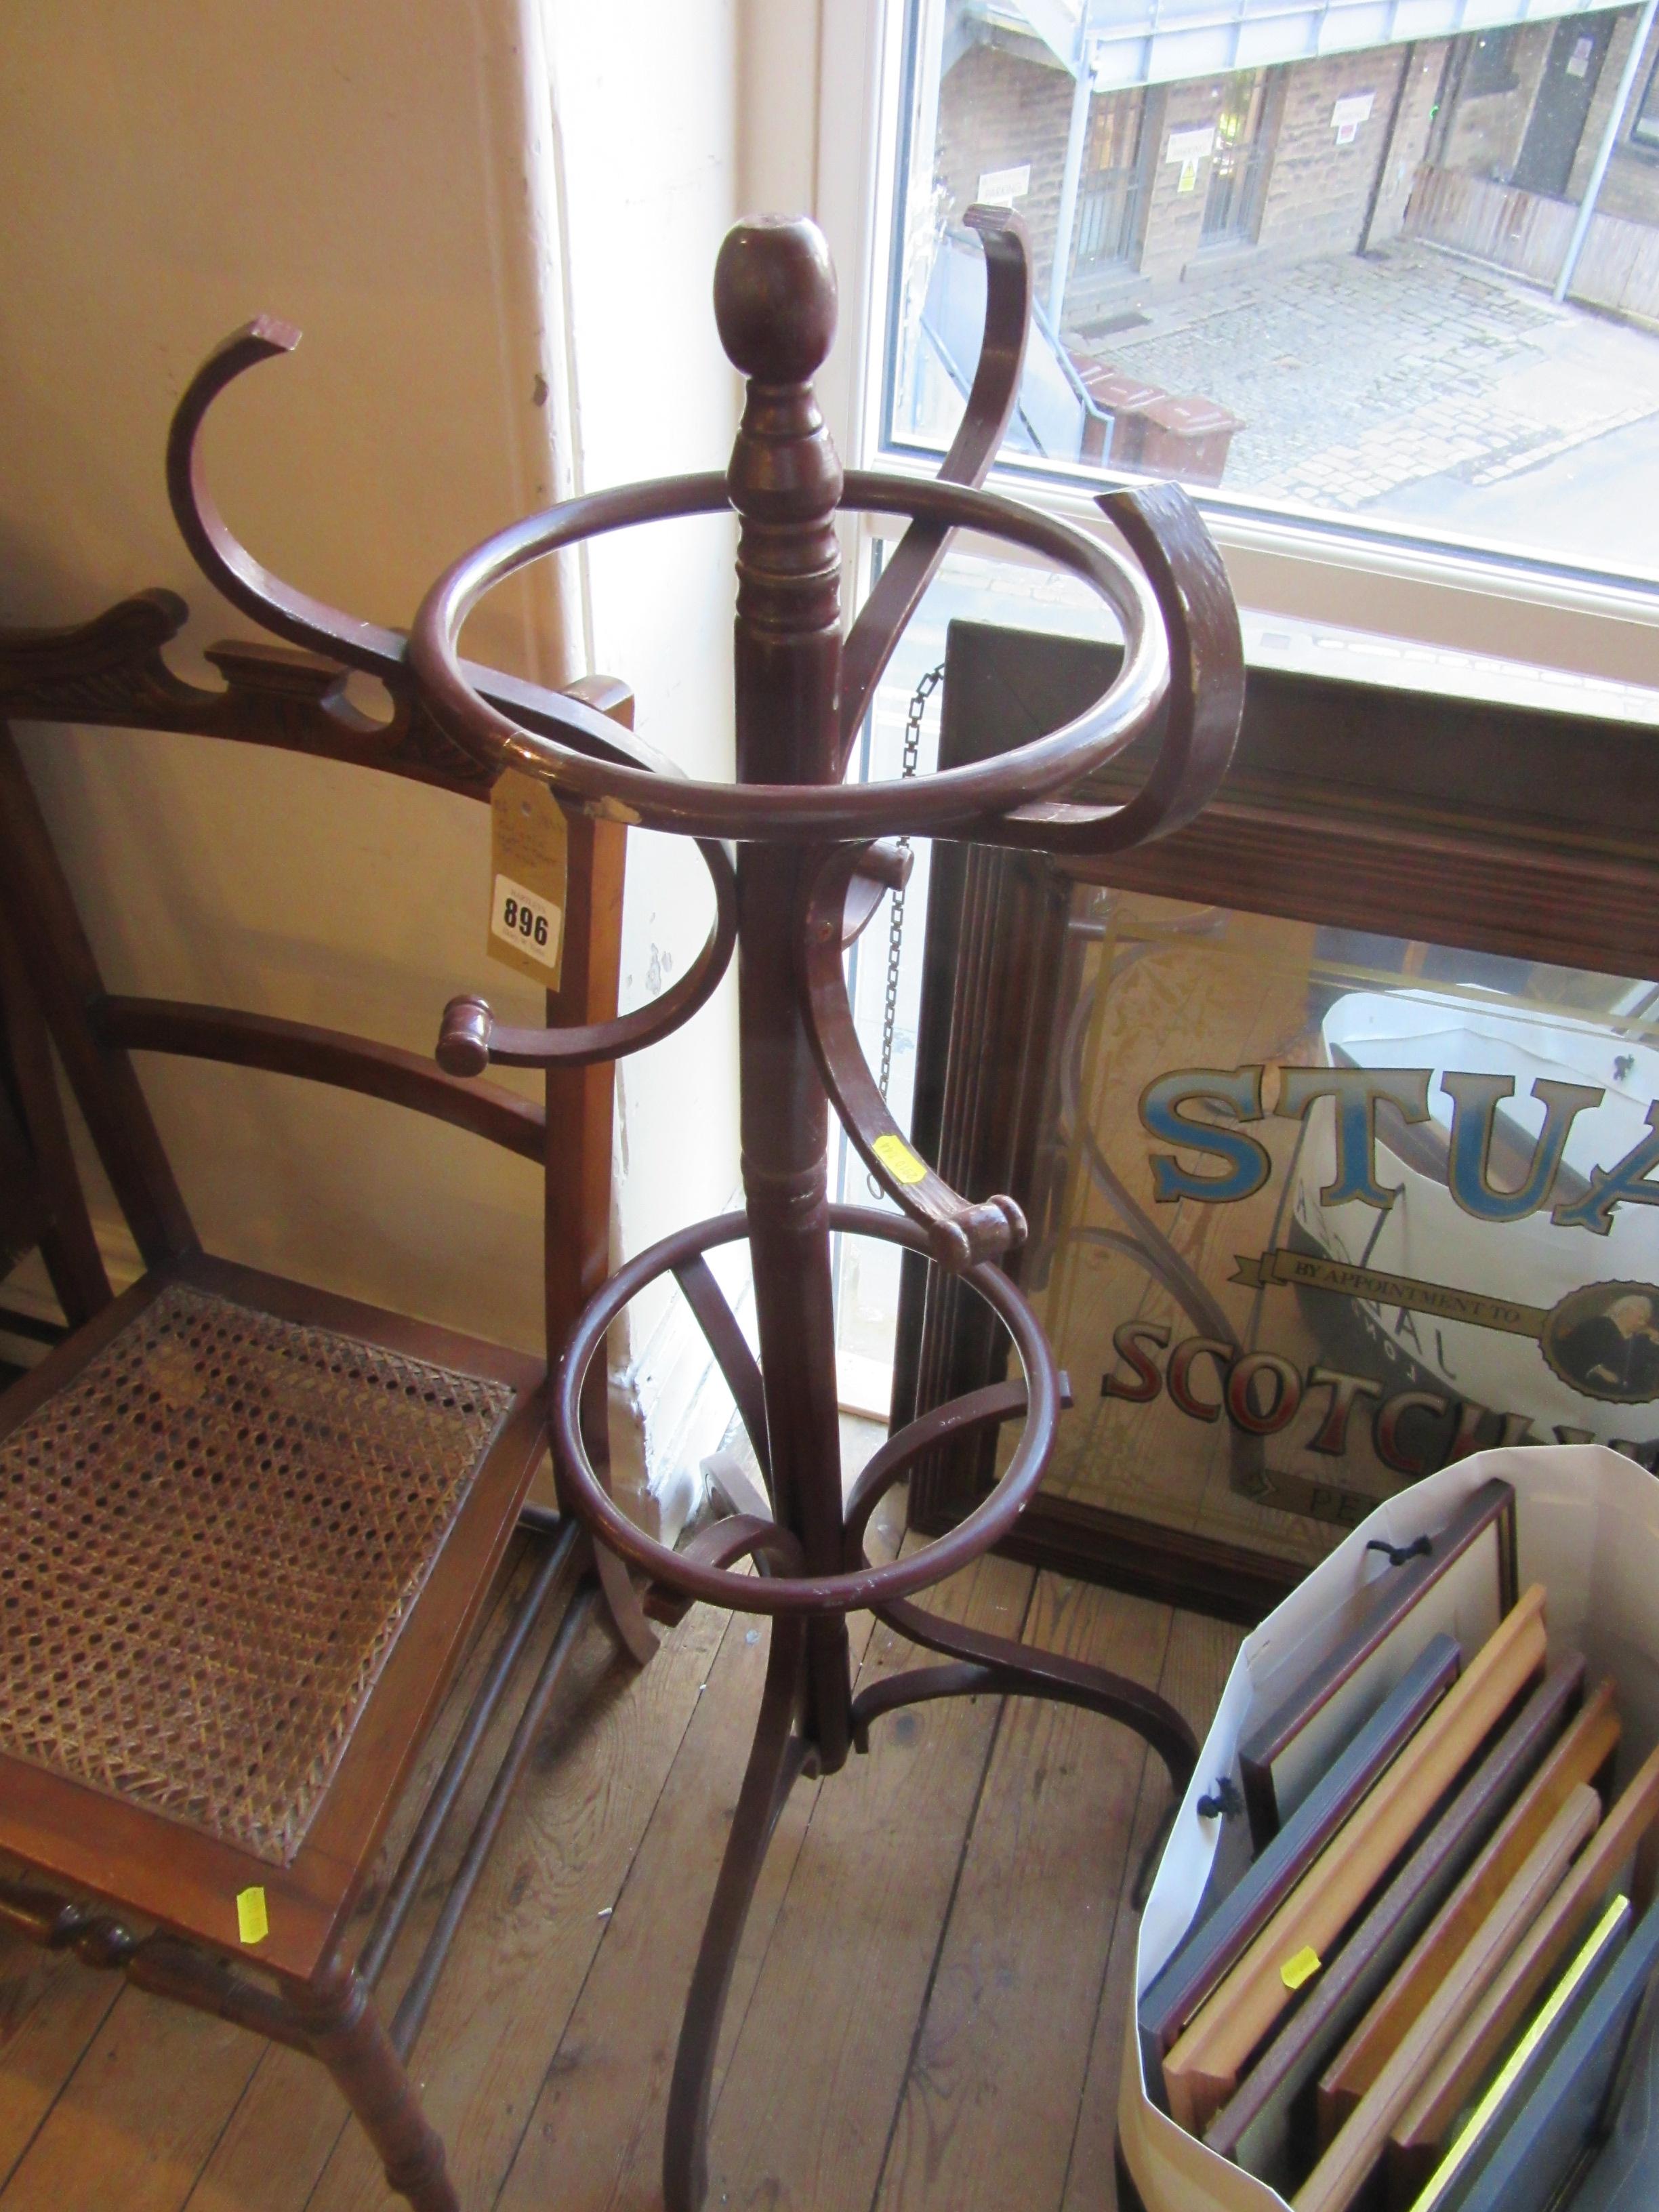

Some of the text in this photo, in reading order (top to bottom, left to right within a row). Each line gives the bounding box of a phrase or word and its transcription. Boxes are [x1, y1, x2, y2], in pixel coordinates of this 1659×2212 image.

[504, 897, 549, 946] 896
[1294, 1261, 1521, 1322] BY APPOINTMENT TO
